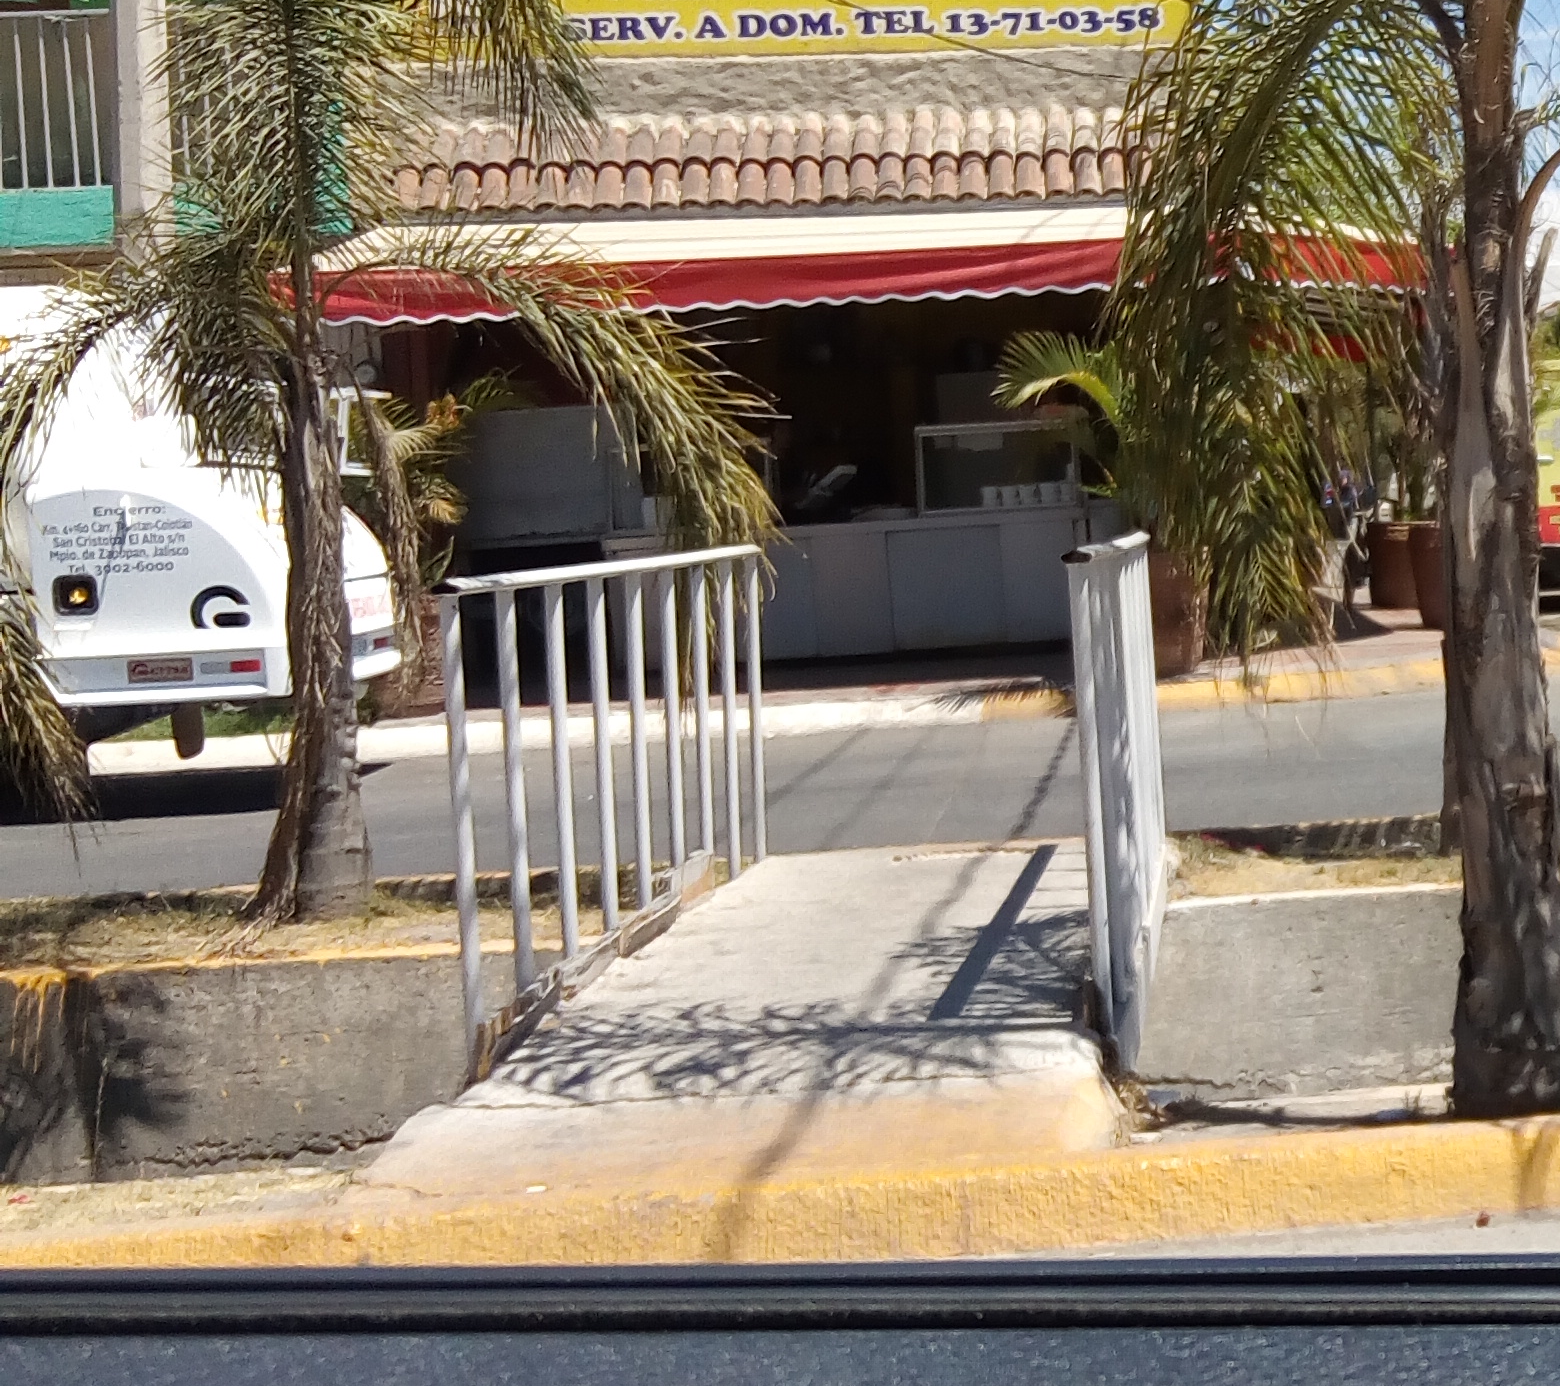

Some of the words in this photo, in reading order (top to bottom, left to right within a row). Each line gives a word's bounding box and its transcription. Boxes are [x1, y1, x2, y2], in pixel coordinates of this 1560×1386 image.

[566, 15, 684, 41] SERV.
[694, 15, 727, 38] A
[737, 12, 845, 38] DOM.
[855, 10, 935, 35] TEL
[946, 7, 1161, 36] 13-71-03-58
[93, 506, 166, 517] Encerro:
